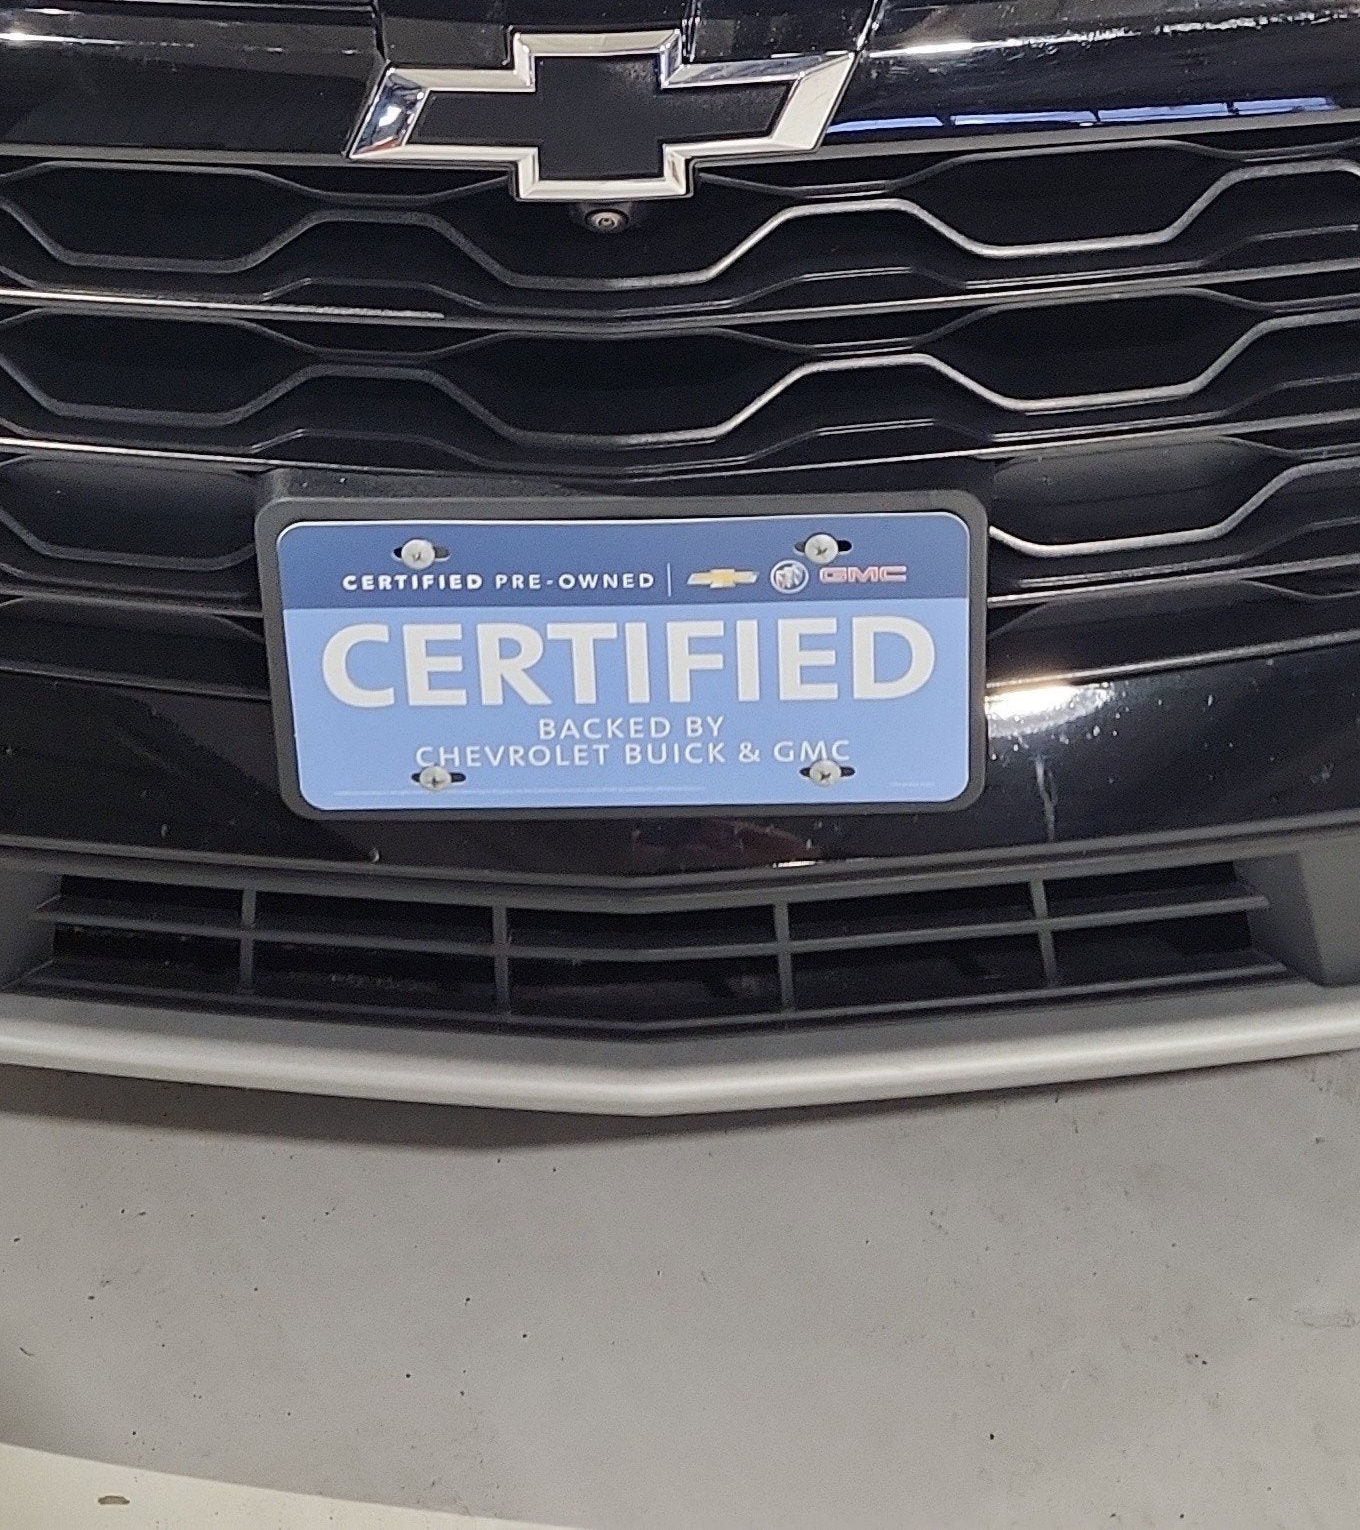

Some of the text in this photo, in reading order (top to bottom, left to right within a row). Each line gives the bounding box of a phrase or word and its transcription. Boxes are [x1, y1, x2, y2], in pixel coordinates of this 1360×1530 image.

[342, 565, 907, 591] CERTIFIED PRE-OWNED GMC
[321, 615, 937, 708] CERTIFIED
[538, 716, 724, 741] BACKED BY
[415, 739, 852, 768] CHEVROLET BUICK & GMC
